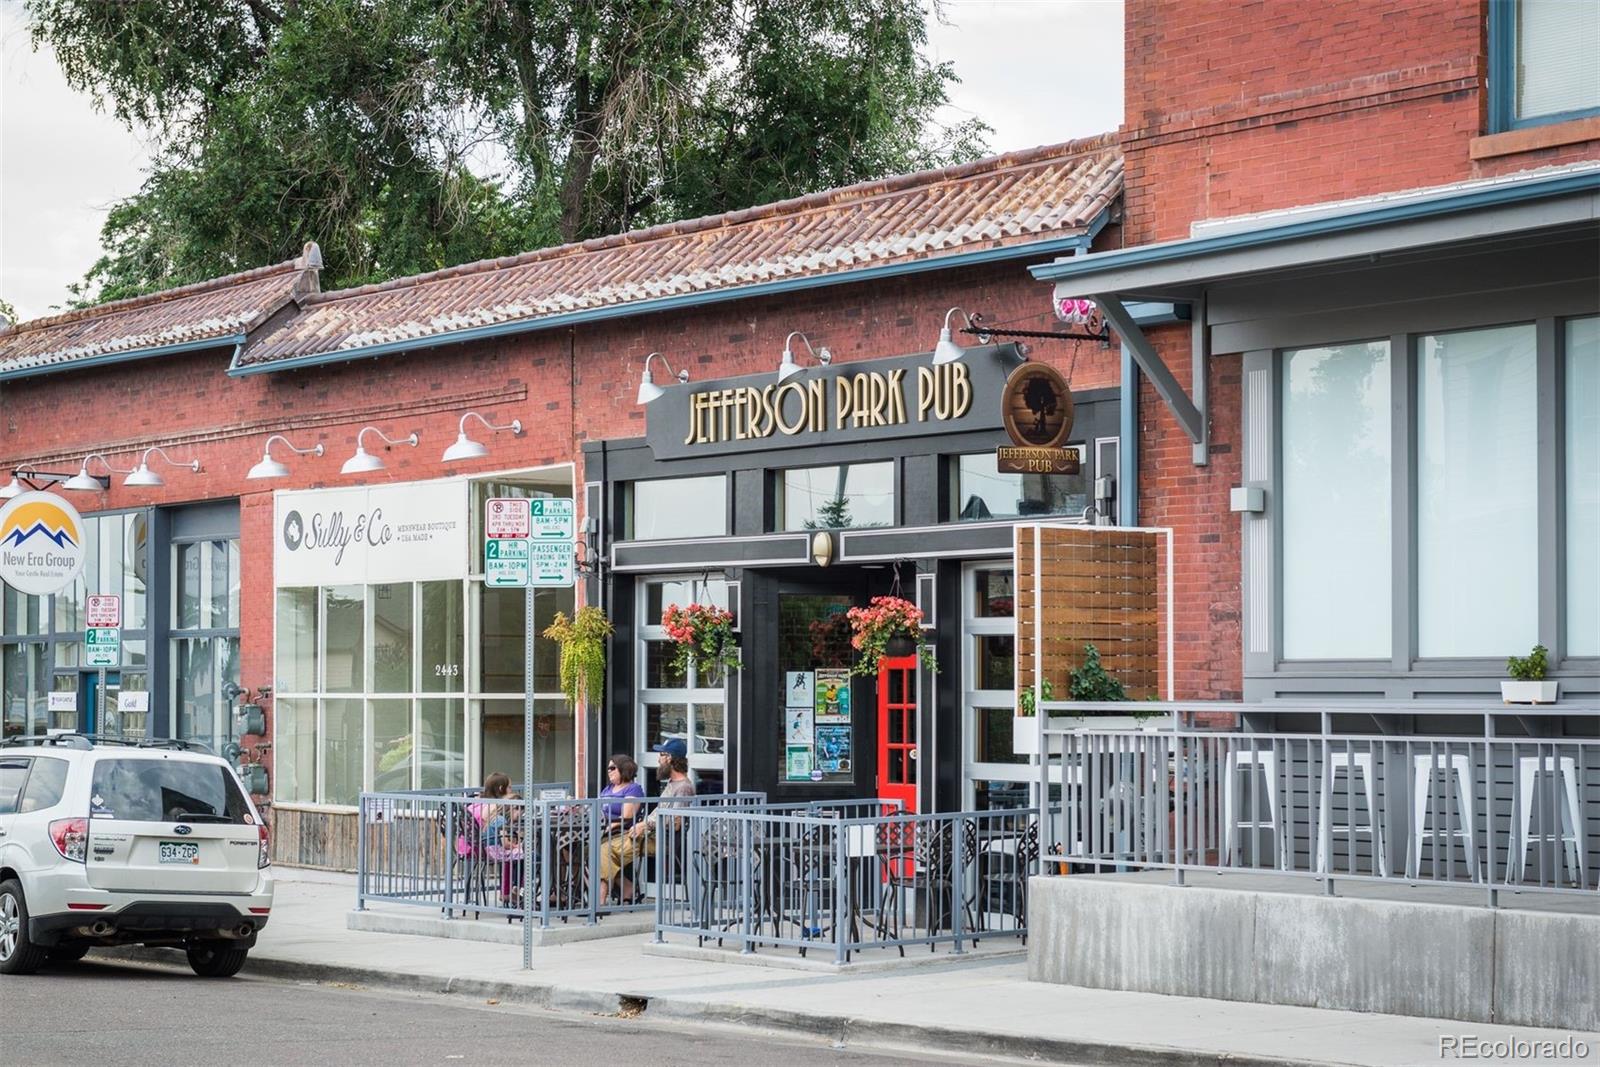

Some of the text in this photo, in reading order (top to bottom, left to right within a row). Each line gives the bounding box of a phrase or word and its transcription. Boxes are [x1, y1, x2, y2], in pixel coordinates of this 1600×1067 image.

[684, 362, 974, 445] JEFFERSON PARK PUB
[998, 447, 1079, 461] JEFFERSON PARK
[1028, 459, 1053, 473] PUB
[533, 502, 541, 515] 2
[305, 508, 393, 567] Sully & Co
[489, 542, 497, 557] 2
[500, 549, 527, 557] PARKING
[532, 544, 571, 553] PASSENGER
[3, 551, 75, 570] New Era Group
[88, 631, 95, 643] 2
[435, 663, 458, 676] 2443
